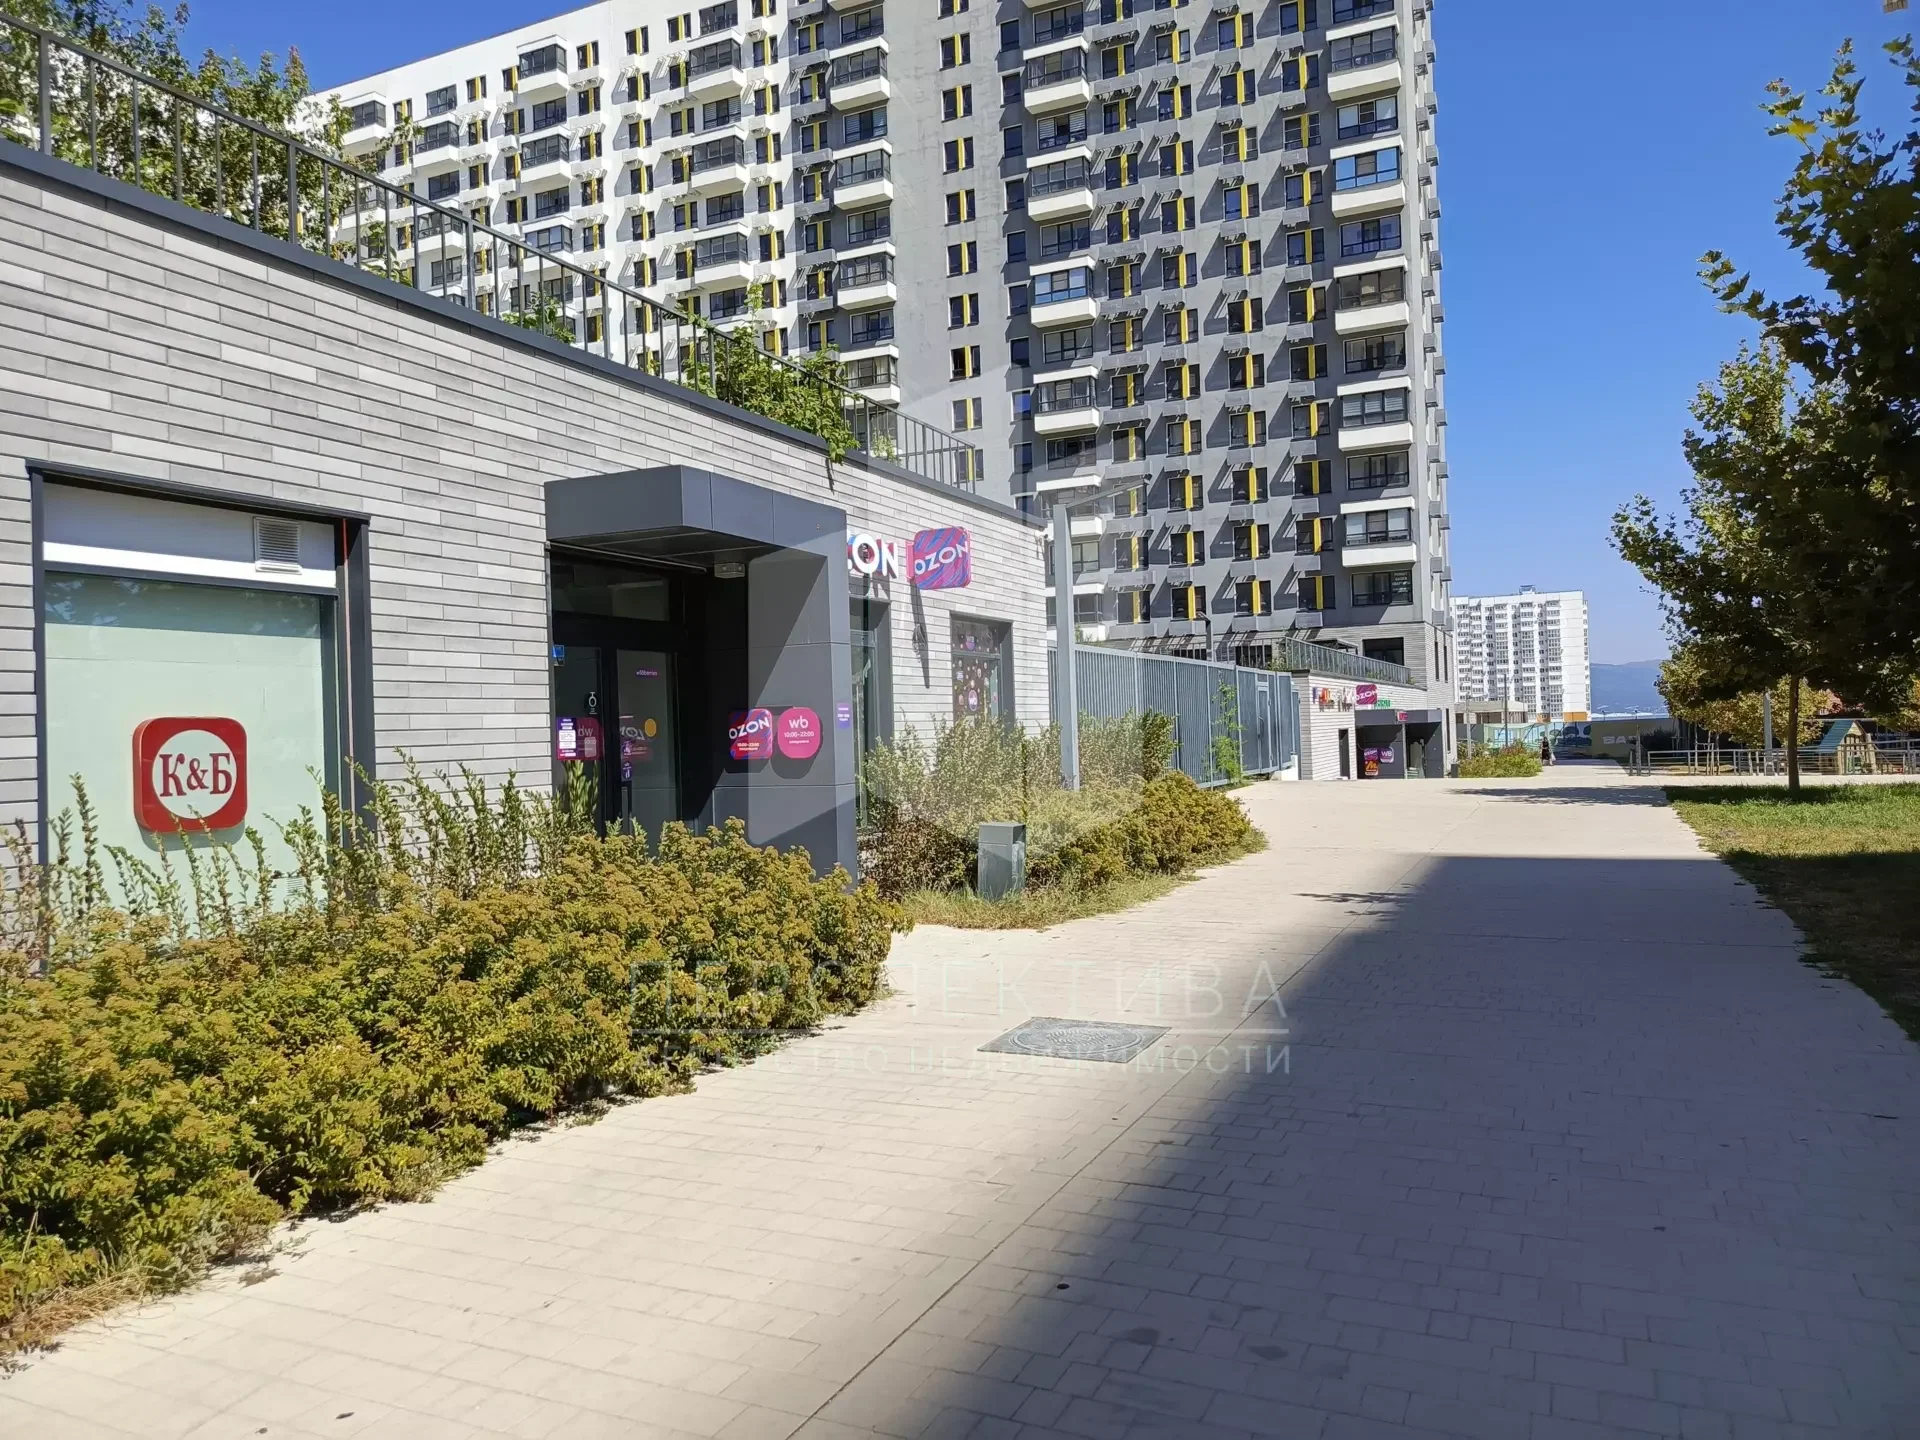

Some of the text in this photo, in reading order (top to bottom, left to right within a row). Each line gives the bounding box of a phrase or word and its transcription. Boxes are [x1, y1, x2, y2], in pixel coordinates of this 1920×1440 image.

[847, 531, 899, 578] ON
[914, 541, 969, 575] OZON
[729, 717, 770, 739] OZON
[788, 715, 809, 729] wb
